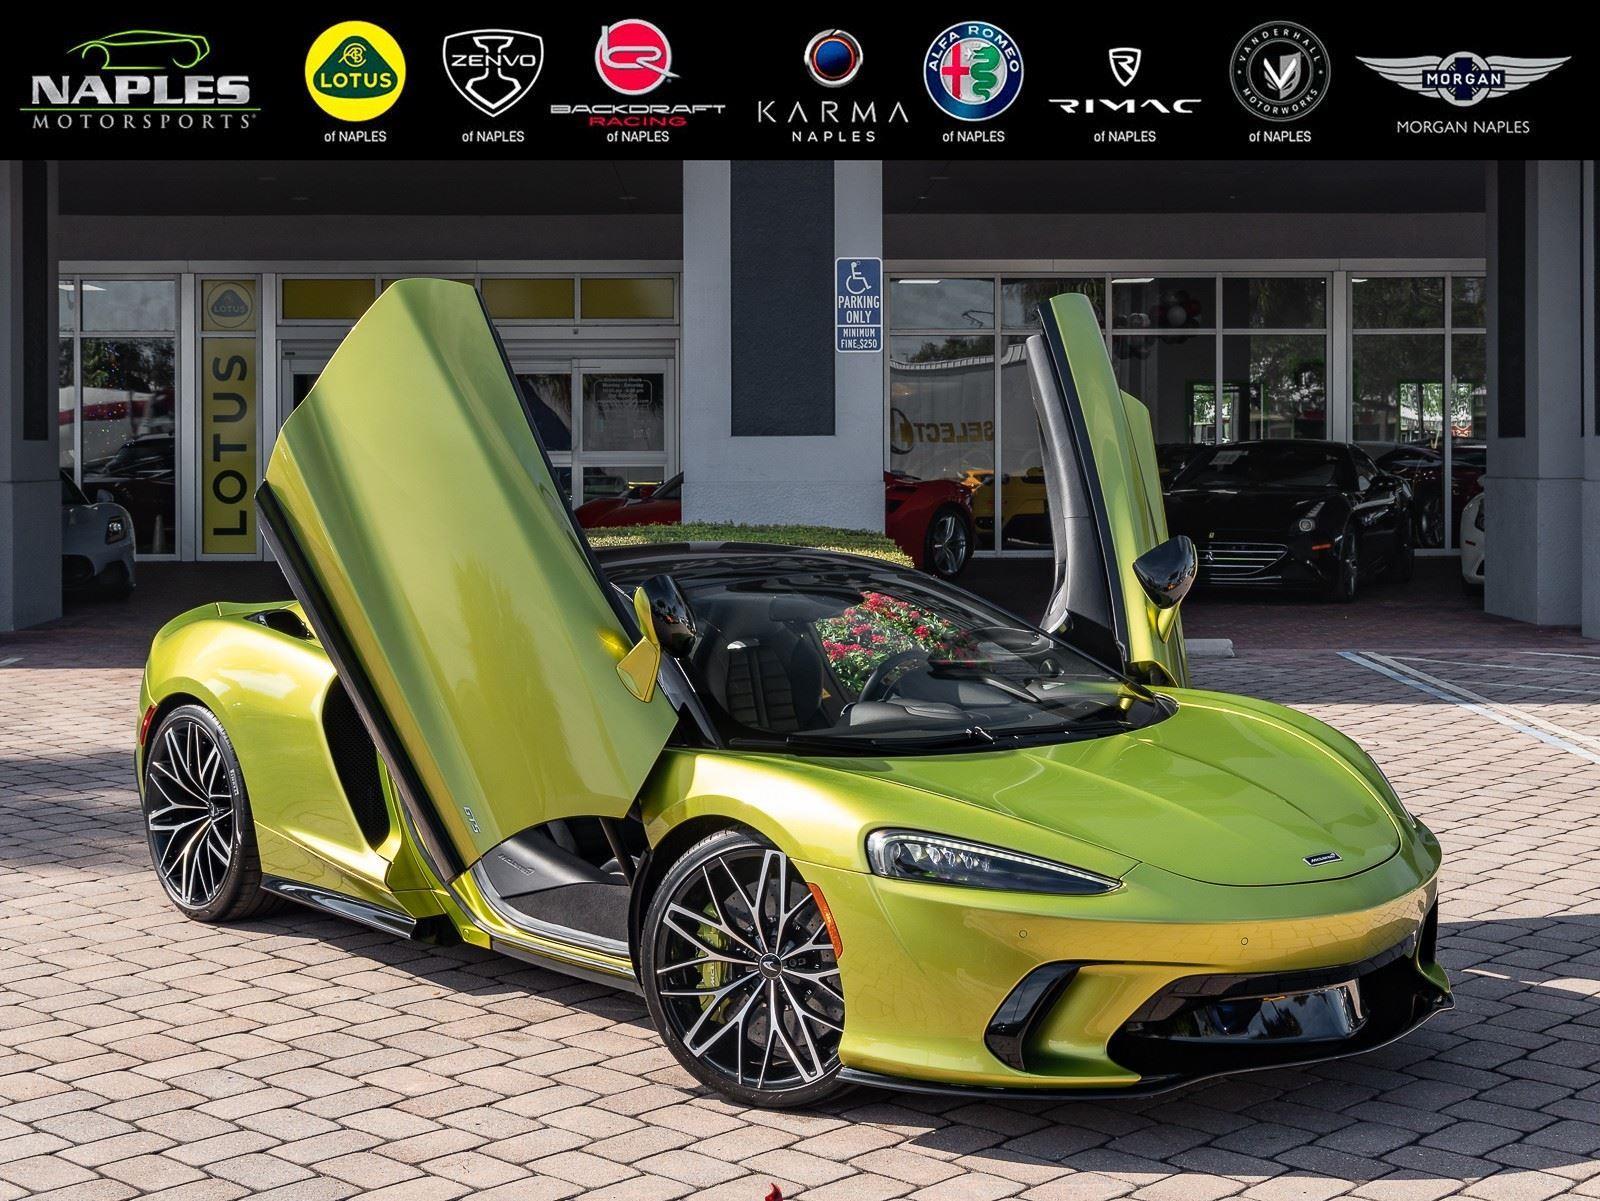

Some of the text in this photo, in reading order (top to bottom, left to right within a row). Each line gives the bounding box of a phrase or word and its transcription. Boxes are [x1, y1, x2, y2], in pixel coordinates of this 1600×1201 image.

[838, 295, 880, 309] PARKING
[846, 310, 872, 324] ONLY
[843, 328, 876, 337] MINIMUM
[840, 339, 878, 349] FINE $250
[212, 355, 248, 536] LOTUS
